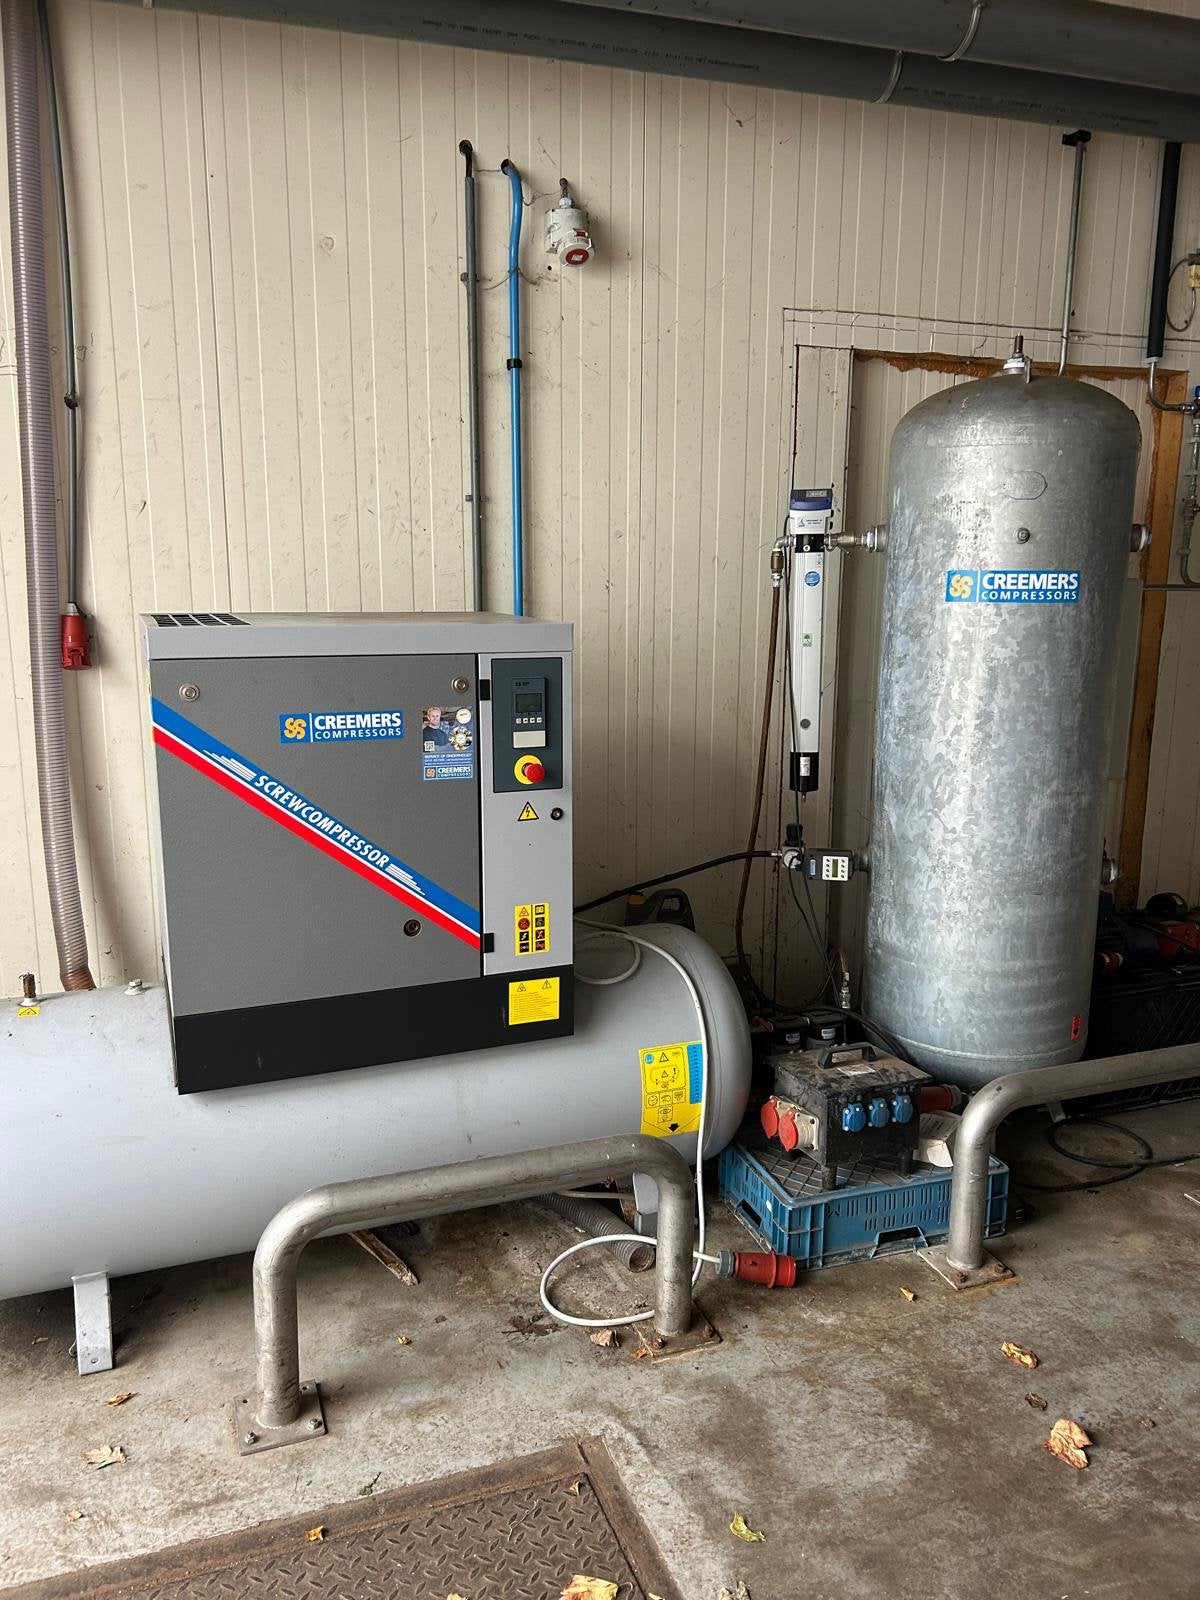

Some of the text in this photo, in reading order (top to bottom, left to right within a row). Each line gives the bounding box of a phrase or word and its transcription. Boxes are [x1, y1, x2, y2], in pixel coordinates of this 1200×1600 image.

[981, 572, 1079, 590] CREEMERS
[981, 590, 1077, 601] COMPRESSORS
[314, 712, 402, 730] CREEMERS
[314, 727, 402, 740] COMPRESSORS
[437, 766, 471, 774] CREEMERS
[254, 775, 390, 868] SCREWCOMPRESSOR
